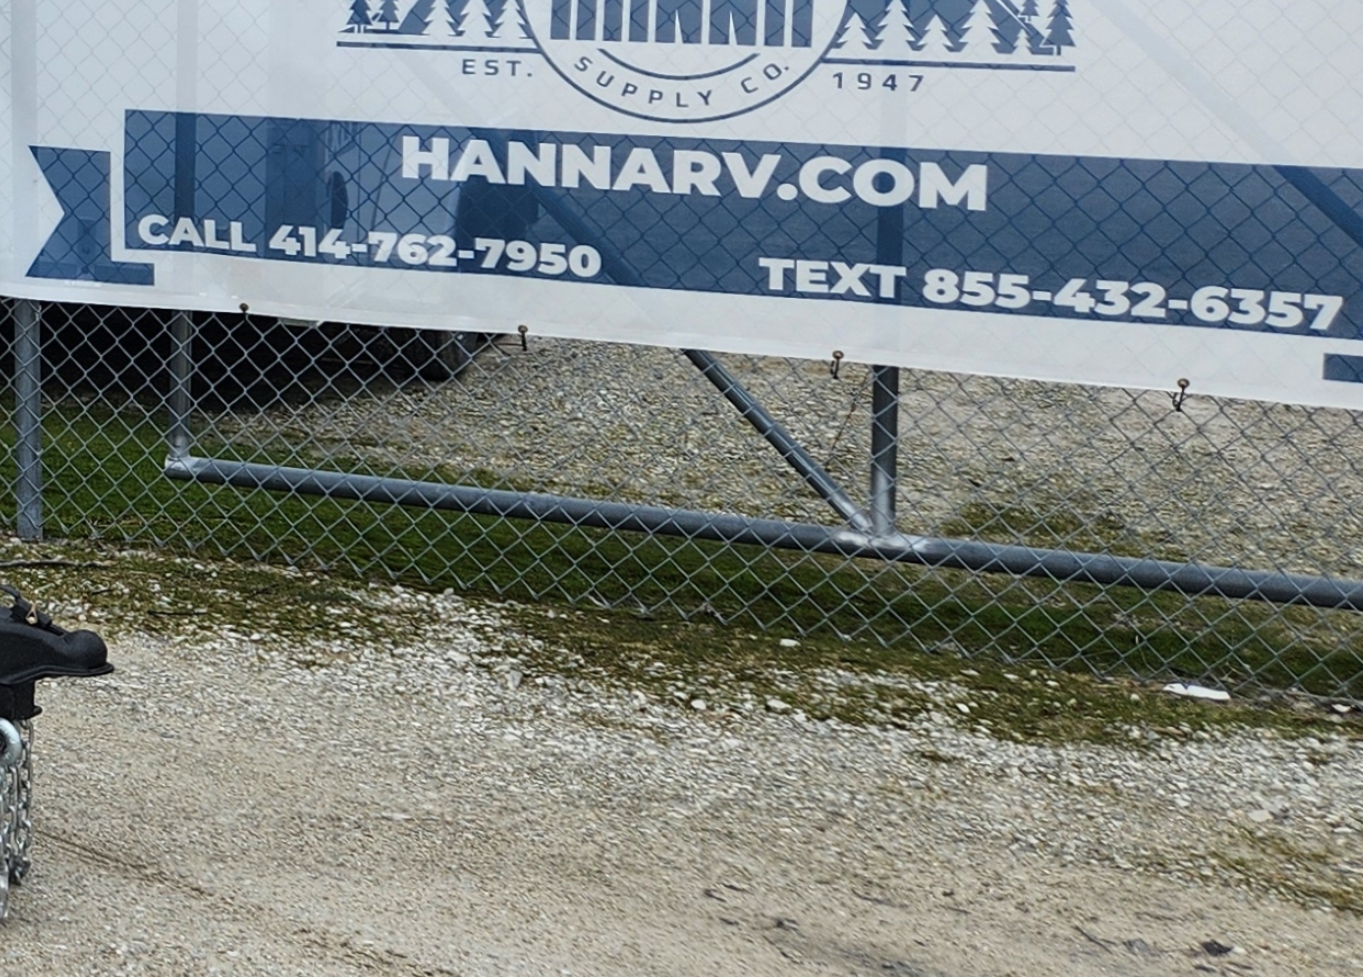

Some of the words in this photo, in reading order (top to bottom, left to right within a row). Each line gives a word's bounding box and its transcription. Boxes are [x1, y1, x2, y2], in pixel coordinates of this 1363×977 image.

[462, 58, 532, 77] EST.
[574, 56, 713, 108] SUPPLY
[740, 62, 790, 95] CO.
[832, 72, 924, 92] 1947
[402, 136, 987, 211] HANNARV.COM
[138, 214, 257, 253] CALL
[268, 224, 602, 278] 414-762-7950
[758, 256, 907, 299] TEXT
[921, 268, 1343, 331] 855-432-6357
